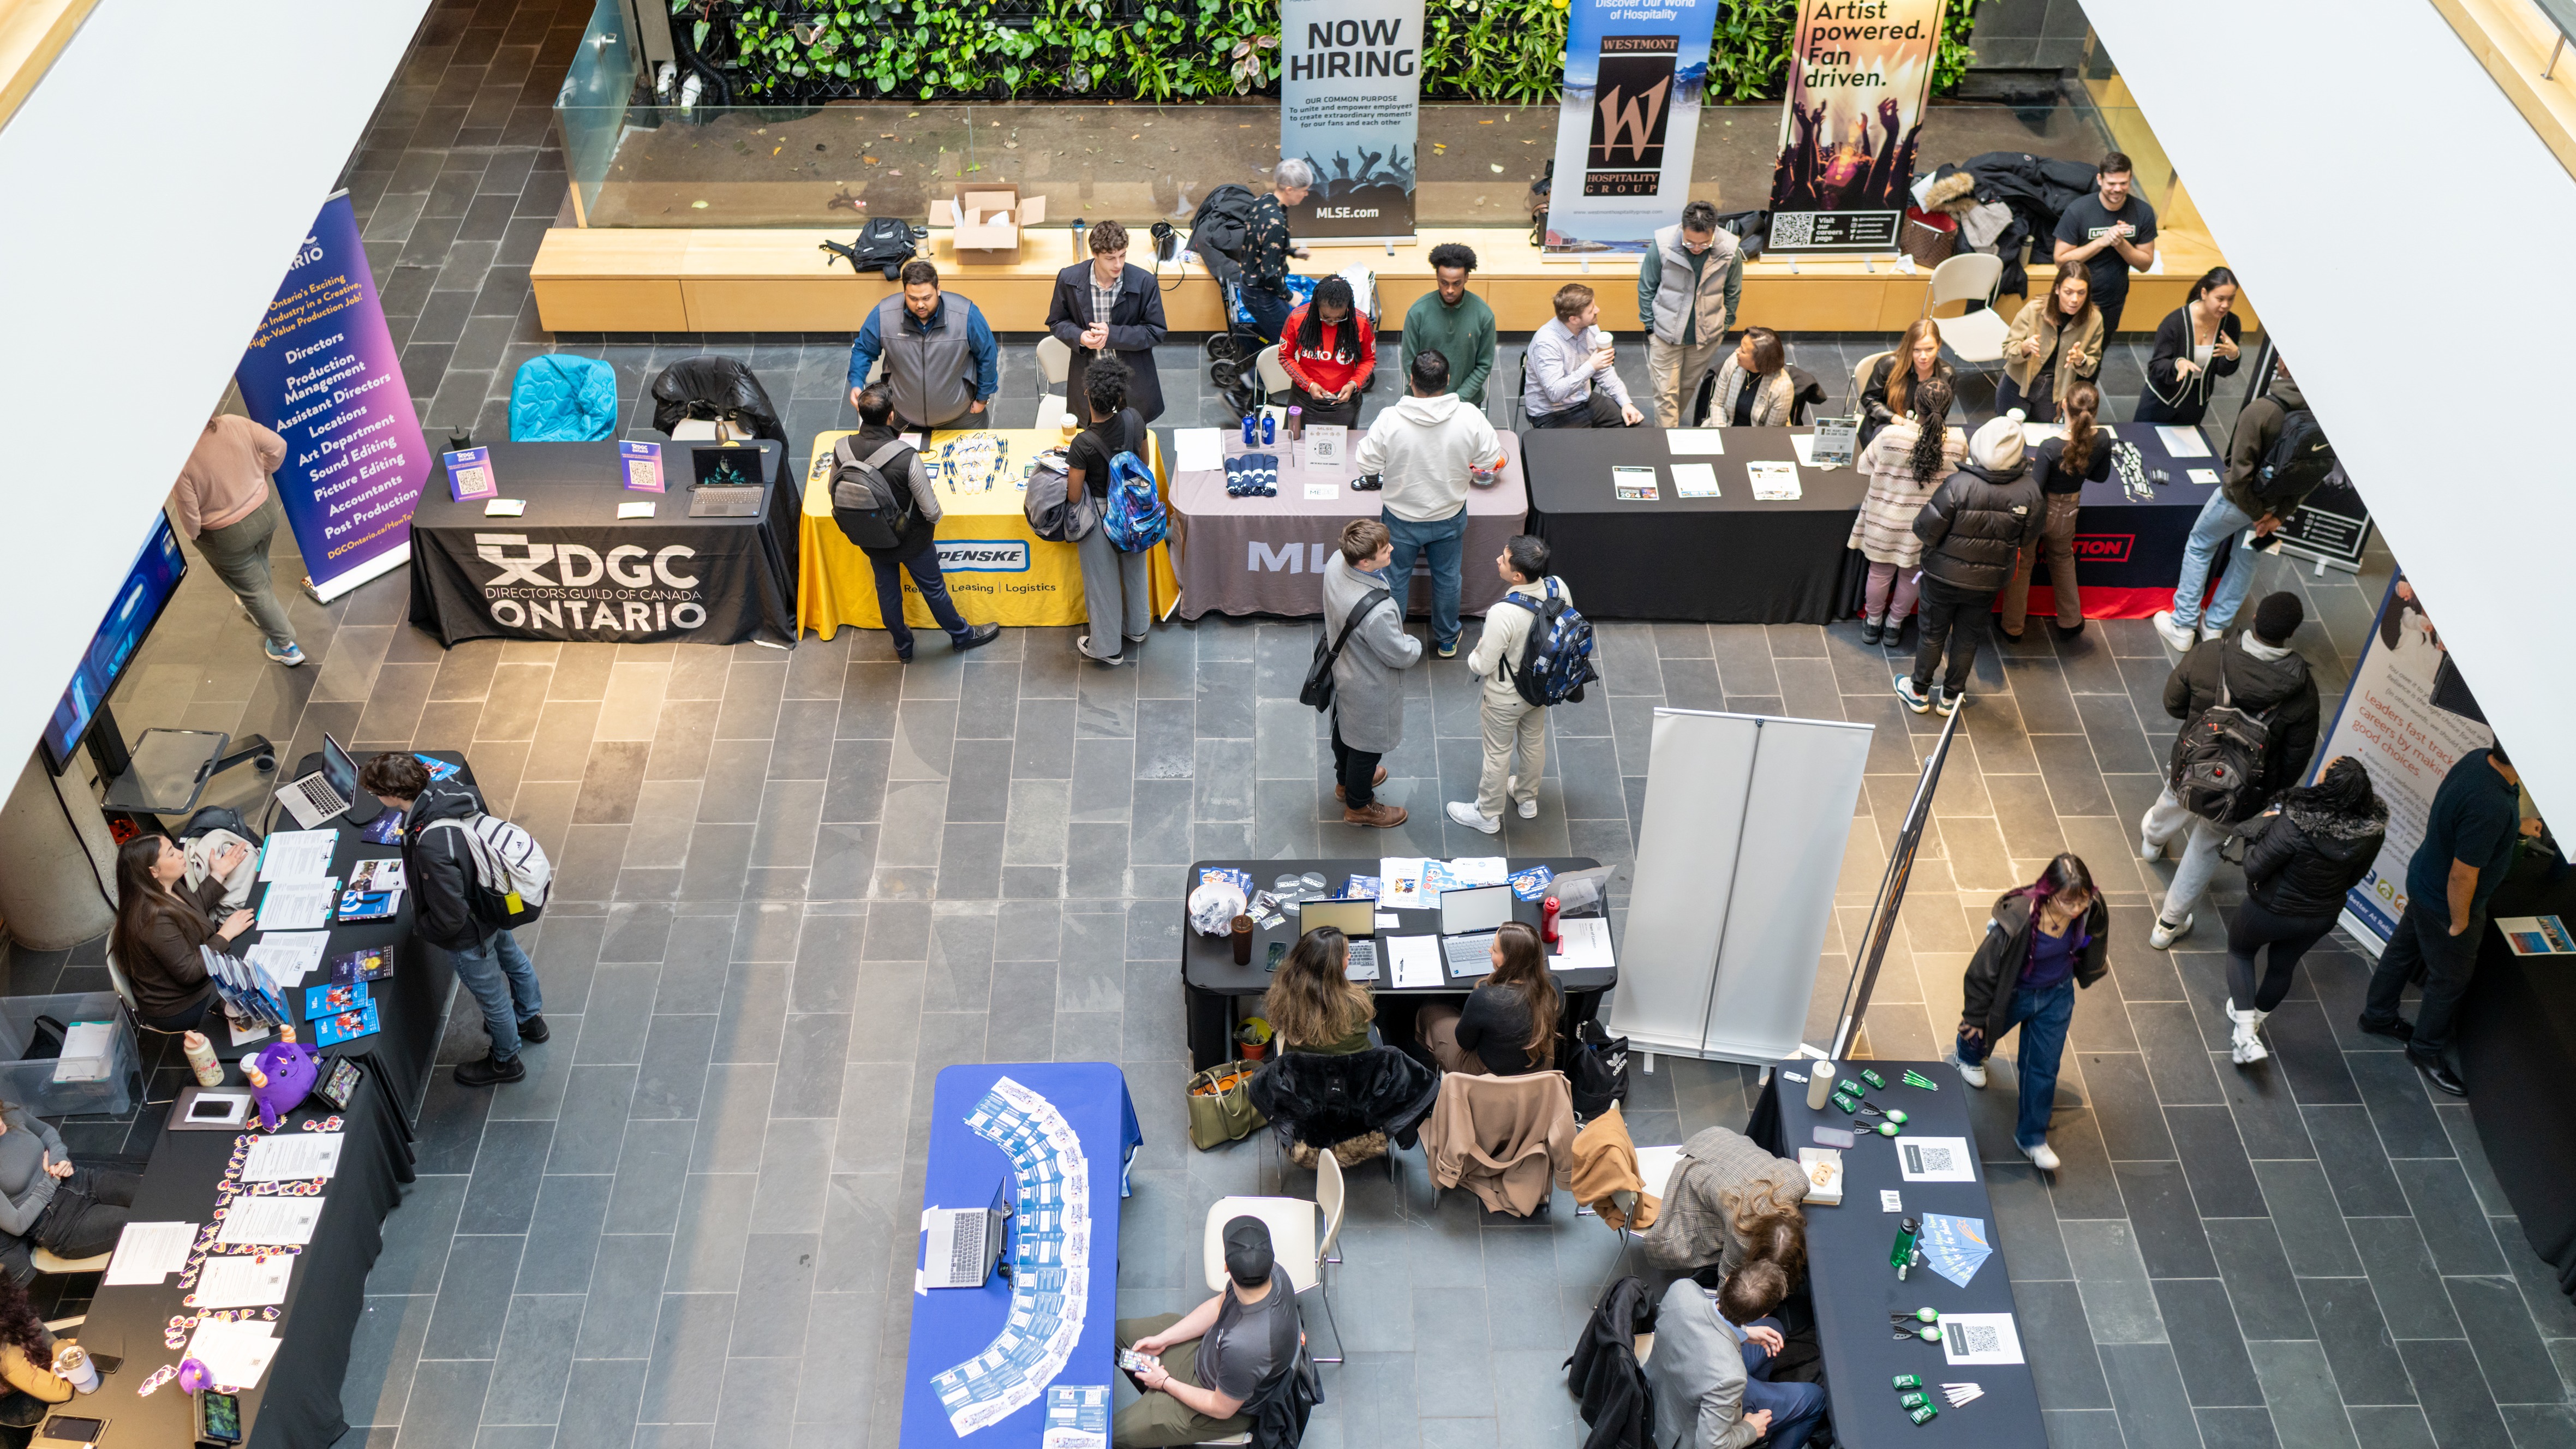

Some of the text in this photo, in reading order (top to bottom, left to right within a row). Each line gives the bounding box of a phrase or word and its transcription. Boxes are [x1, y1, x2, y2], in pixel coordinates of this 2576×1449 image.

[1610, 9, 1678, 21] of Hospitality
[1814, 0, 1887, 20] Artist
[1308, 19, 1402, 50] NOW
[1603, 39, 1678, 50] WESTMONT
[1810, 20, 1926, 46] powered.
[1291, 49, 1414, 81] HIRING
[1808, 47, 1851, 65] Fan
[1804, 68, 1886, 87] driven.
[1587, 173, 1658, 183] HOSPITALITY
[1317, 207, 1379, 218] MLSE.com
[298, 242, 319, 253] ANADA
[309, 274, 346, 293] Exciting
[269, 305, 305, 326] Industry
[306, 301, 315, 309] in
[323, 282, 362, 301] Creative,
[248, 292, 363, 350] High-Value Production Job!
[285, 333, 344, 365] Directors
[285, 361, 366, 405] Management
[286, 354, 355, 390] Production
[277, 373, 391, 433] Assistant Directors
[308, 406, 367, 439] Locations
[299, 414, 396, 467] Art Department
[309, 436, 397, 482] Sound Editing
[314, 453, 406, 502] Picture Editing
[330, 475, 403, 517] Accountants
[325, 489, 419, 540] Post Production
[937, 550, 1023, 562] PENSKE
[1248, 541, 1327, 574] ML
[2072, 541, 2122, 554] TION
[556, 544, 700, 589] DGC
[485, 587, 702, 601] DIRECTORS GUILD OF CANADA
[951, 583, 1056, 595] Leasing Logistics
[490, 600, 707, 632] ONTARIO
[2387, 674, 2411, 697] Reliance
[2364, 690, 2404, 727] Leaders
[2406, 722, 2426, 745] fast
[2352, 720, 2420, 779] good choices.
[2359, 706, 2447, 780] careers by makin
[2458, 745, 2468, 757] tal
[2348, 894, 2369, 914] Better
[2369, 913, 2377, 923] At
[1613, 1059, 1627, 1076] adidas
[1928, 1215, 1946, 1244] Your time
[1939, 1219, 1952, 1236] shine
